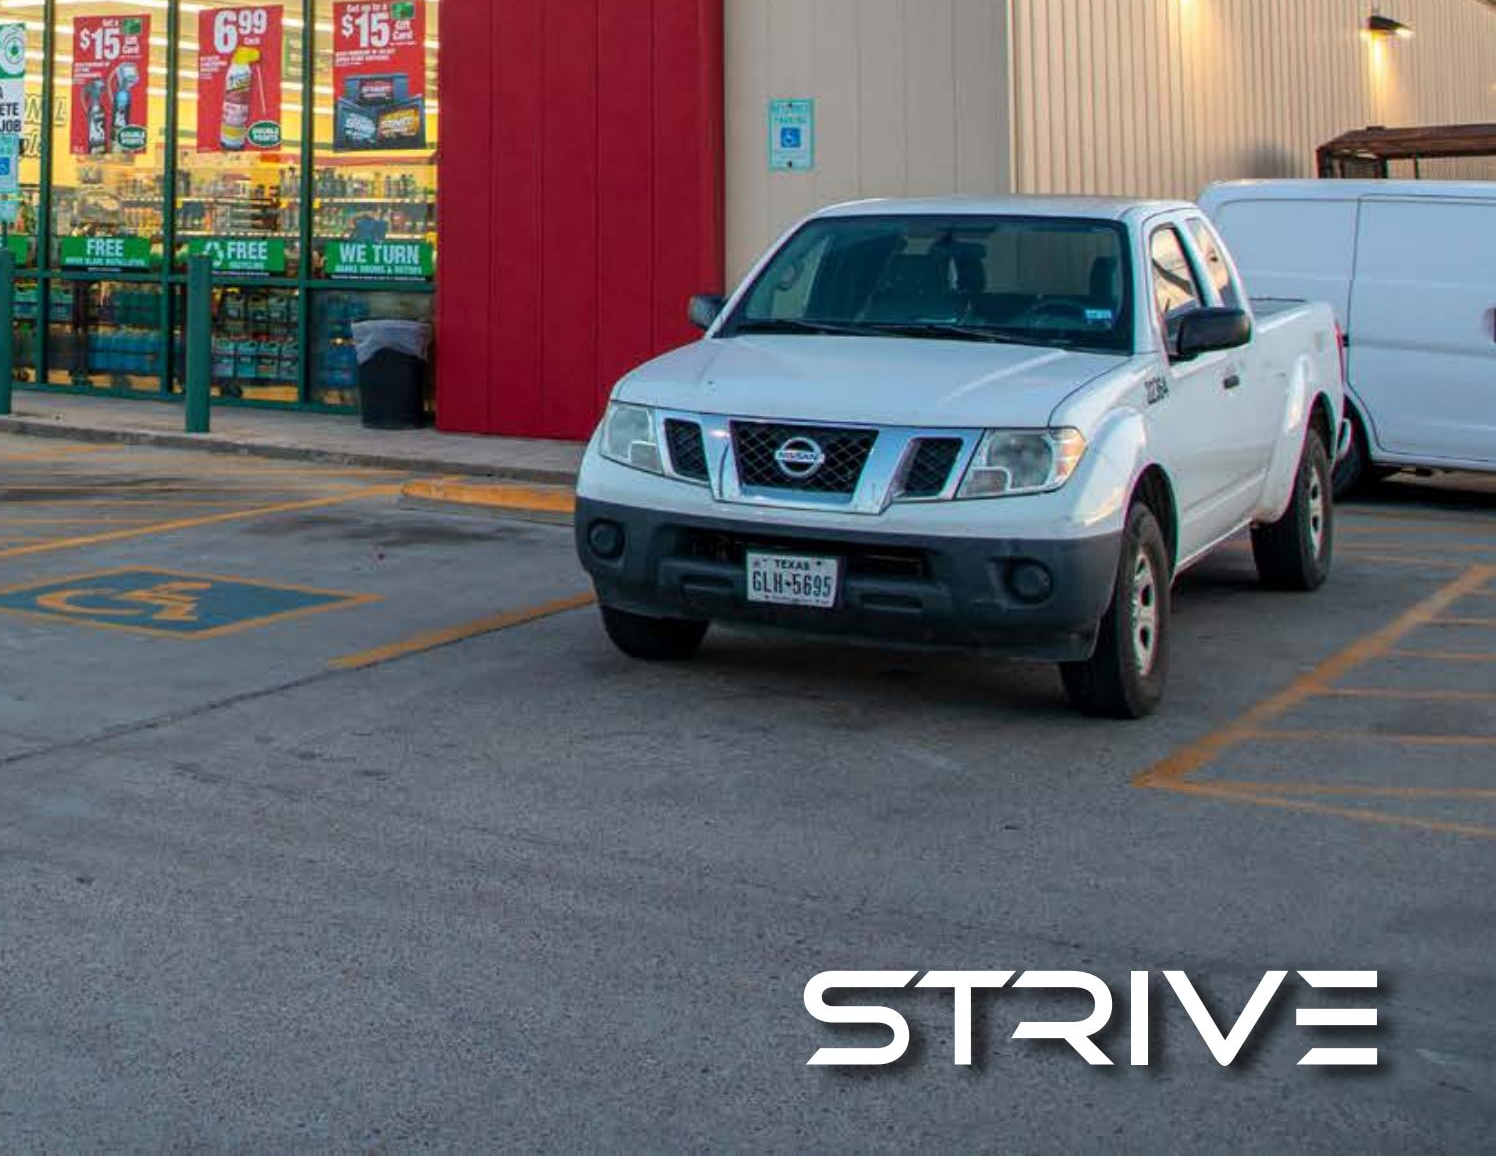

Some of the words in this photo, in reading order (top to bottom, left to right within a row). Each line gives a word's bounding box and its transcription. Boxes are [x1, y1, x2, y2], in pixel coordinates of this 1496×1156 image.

[341, 12, 390, 48] $15
[80, 26, 120, 60] $15
[86, 238, 124, 256] FREE
[227, 241, 268, 259] FREE
[339, 243, 367, 263] WE
[372, 244, 420, 264] TURN
[775, 558, 810, 571] TEXAS
